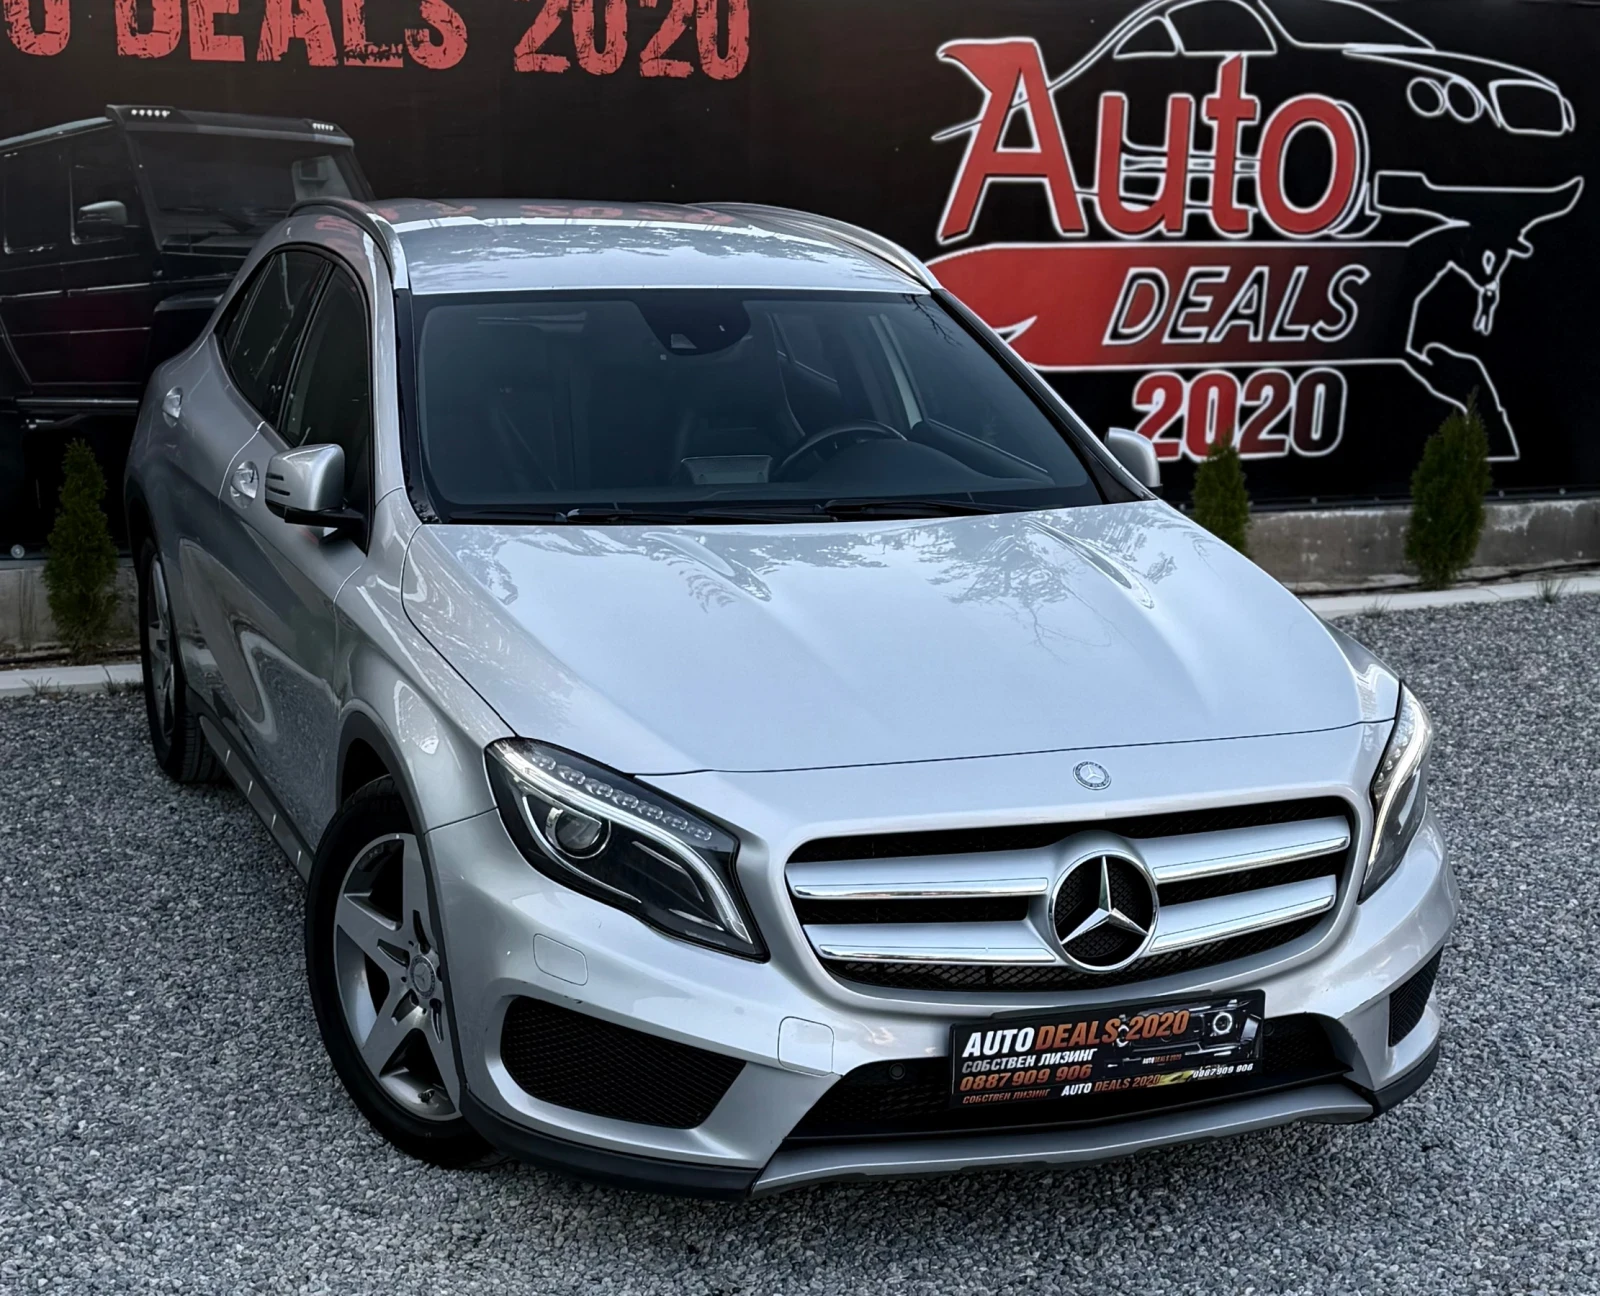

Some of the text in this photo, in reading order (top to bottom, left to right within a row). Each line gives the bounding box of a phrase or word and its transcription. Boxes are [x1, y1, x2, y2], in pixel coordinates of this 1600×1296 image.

[115, 0, 469, 70] DEALS
[512, 0, 752, 80] 2020
[937, 37, 1362, 243] Auto
[1102, 264, 1371, 347] DEALS
[1132, 367, 1348, 462] 2020
[961, 1009, 1190, 1058] AUTO DEALS 2020
[961, 1048, 1098, 1074] СОБСТВЕН ЛИЗИНГ
[959, 1063, 1093, 1092] 0887 909 906
[1060, 1074, 1161, 1097] AUTO DEALS 2020
